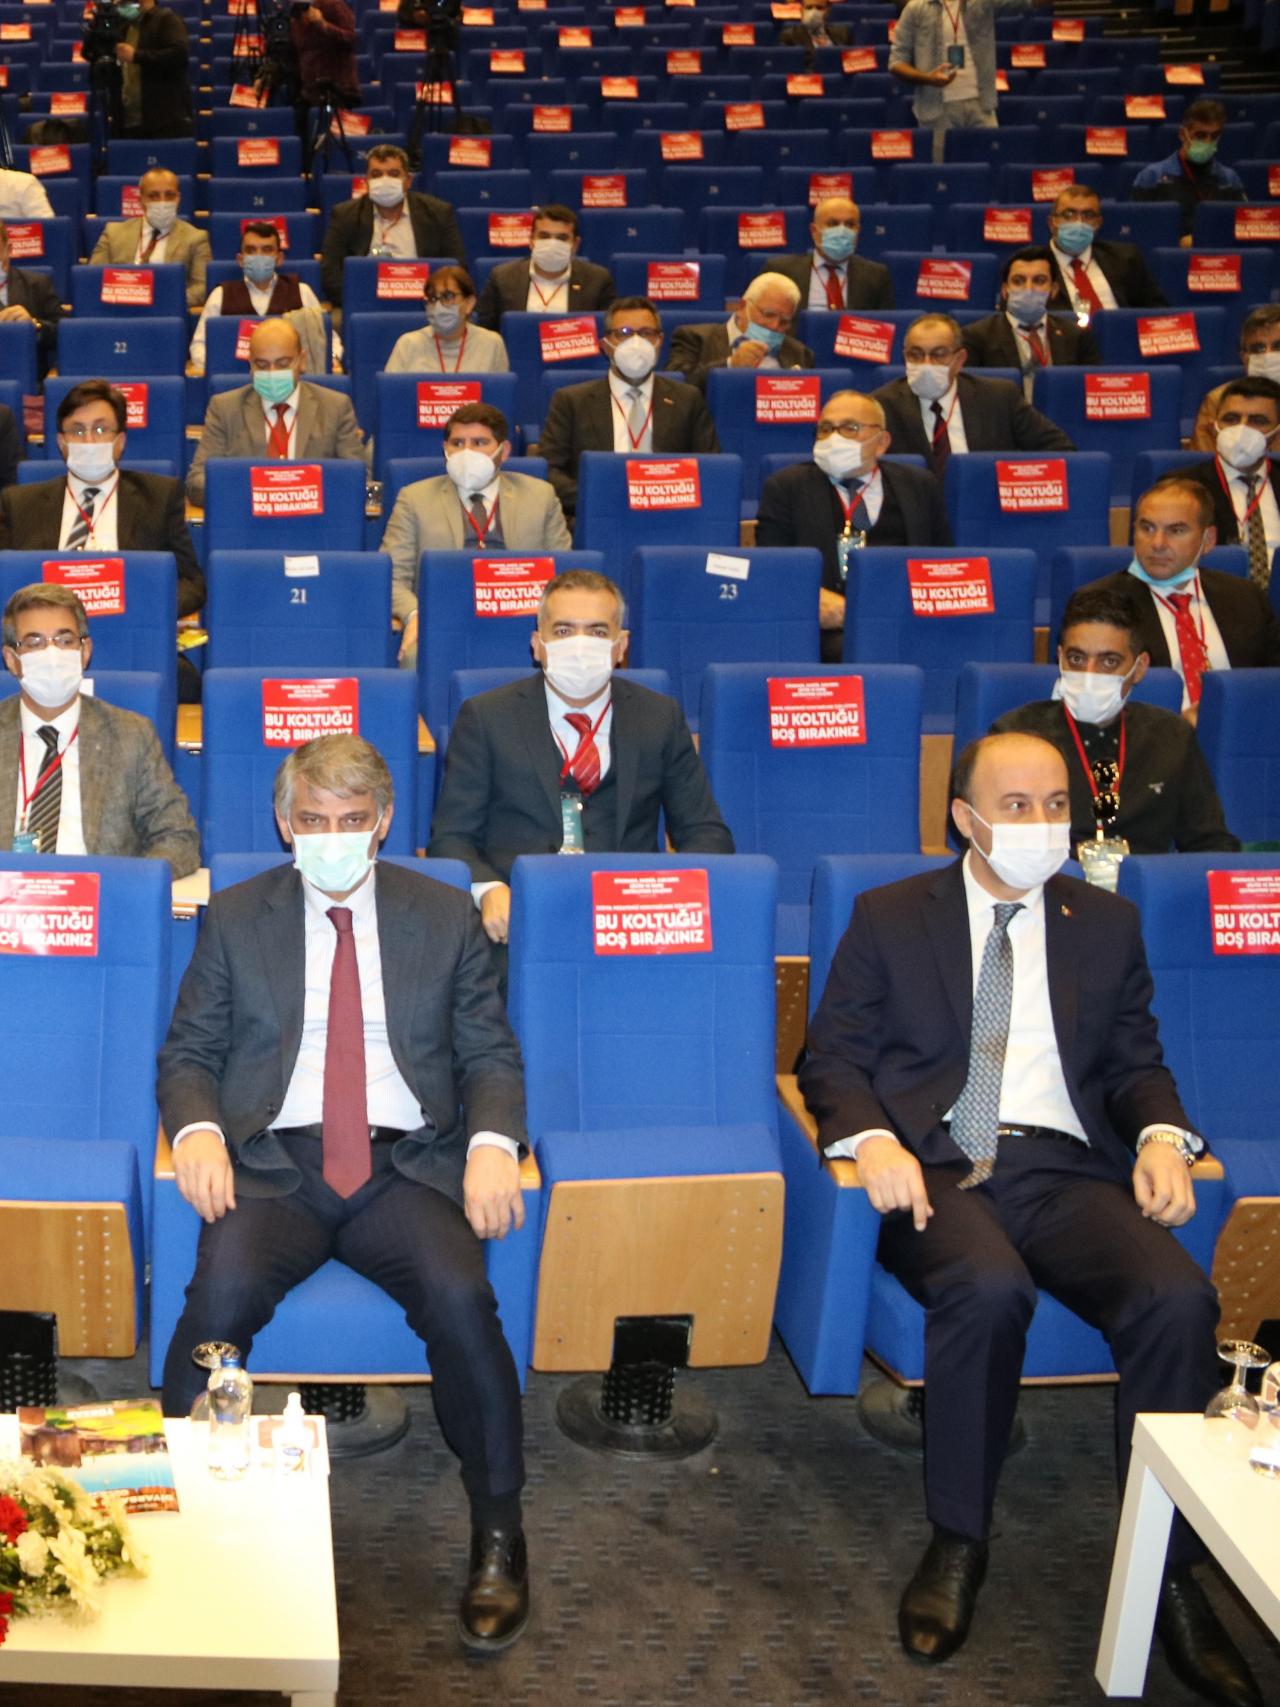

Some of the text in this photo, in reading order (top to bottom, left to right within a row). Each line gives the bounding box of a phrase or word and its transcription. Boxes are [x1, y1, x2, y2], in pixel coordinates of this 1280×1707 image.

[756, 398, 815, 409] BU KOLTUĞU
[1086, 394, 1145, 406] BU KOLTUĞU
[252, 489, 318, 502] BU KOLTUĞU
[628, 482, 695, 495] BU KOLTUĞU
[998, 484, 1062, 497] BU KOLTUĞU
[253, 501, 318, 514] BOŞ BIRAKINIZ
[629, 496, 648, 507] BOŞ
[73, 586, 119, 600] OLTUĞU
[290, 588, 307, 604] 21
[475, 585, 546, 600] BU KOLTUĞ
[719, 584, 738, 600] 23
[910, 584, 987, 599] BU KOLTUĞU
[475, 601, 498, 612] BOŞ
[912, 598, 988, 612] BOŞ BIRAKINIZ
[264, 710, 352, 727] BU KOLTUĞU
[769, 708, 858, 726] BU KOLTUĞU
[264, 728, 290, 742] BOŞ
[770, 726, 859, 742] BOŞ BIRAKINIZ
[16, 912, 93, 930] KOLTUĞU
[594, 908, 703, 930] BU KOLTUĞU
[1214, 912, 1280, 928] BU KOLT
[23, 932, 93, 946] BIRAKINIZ
[595, 929, 704, 949] BOŞ BIRAKINIZ
[1216, 931, 1244, 949] BOŞ
